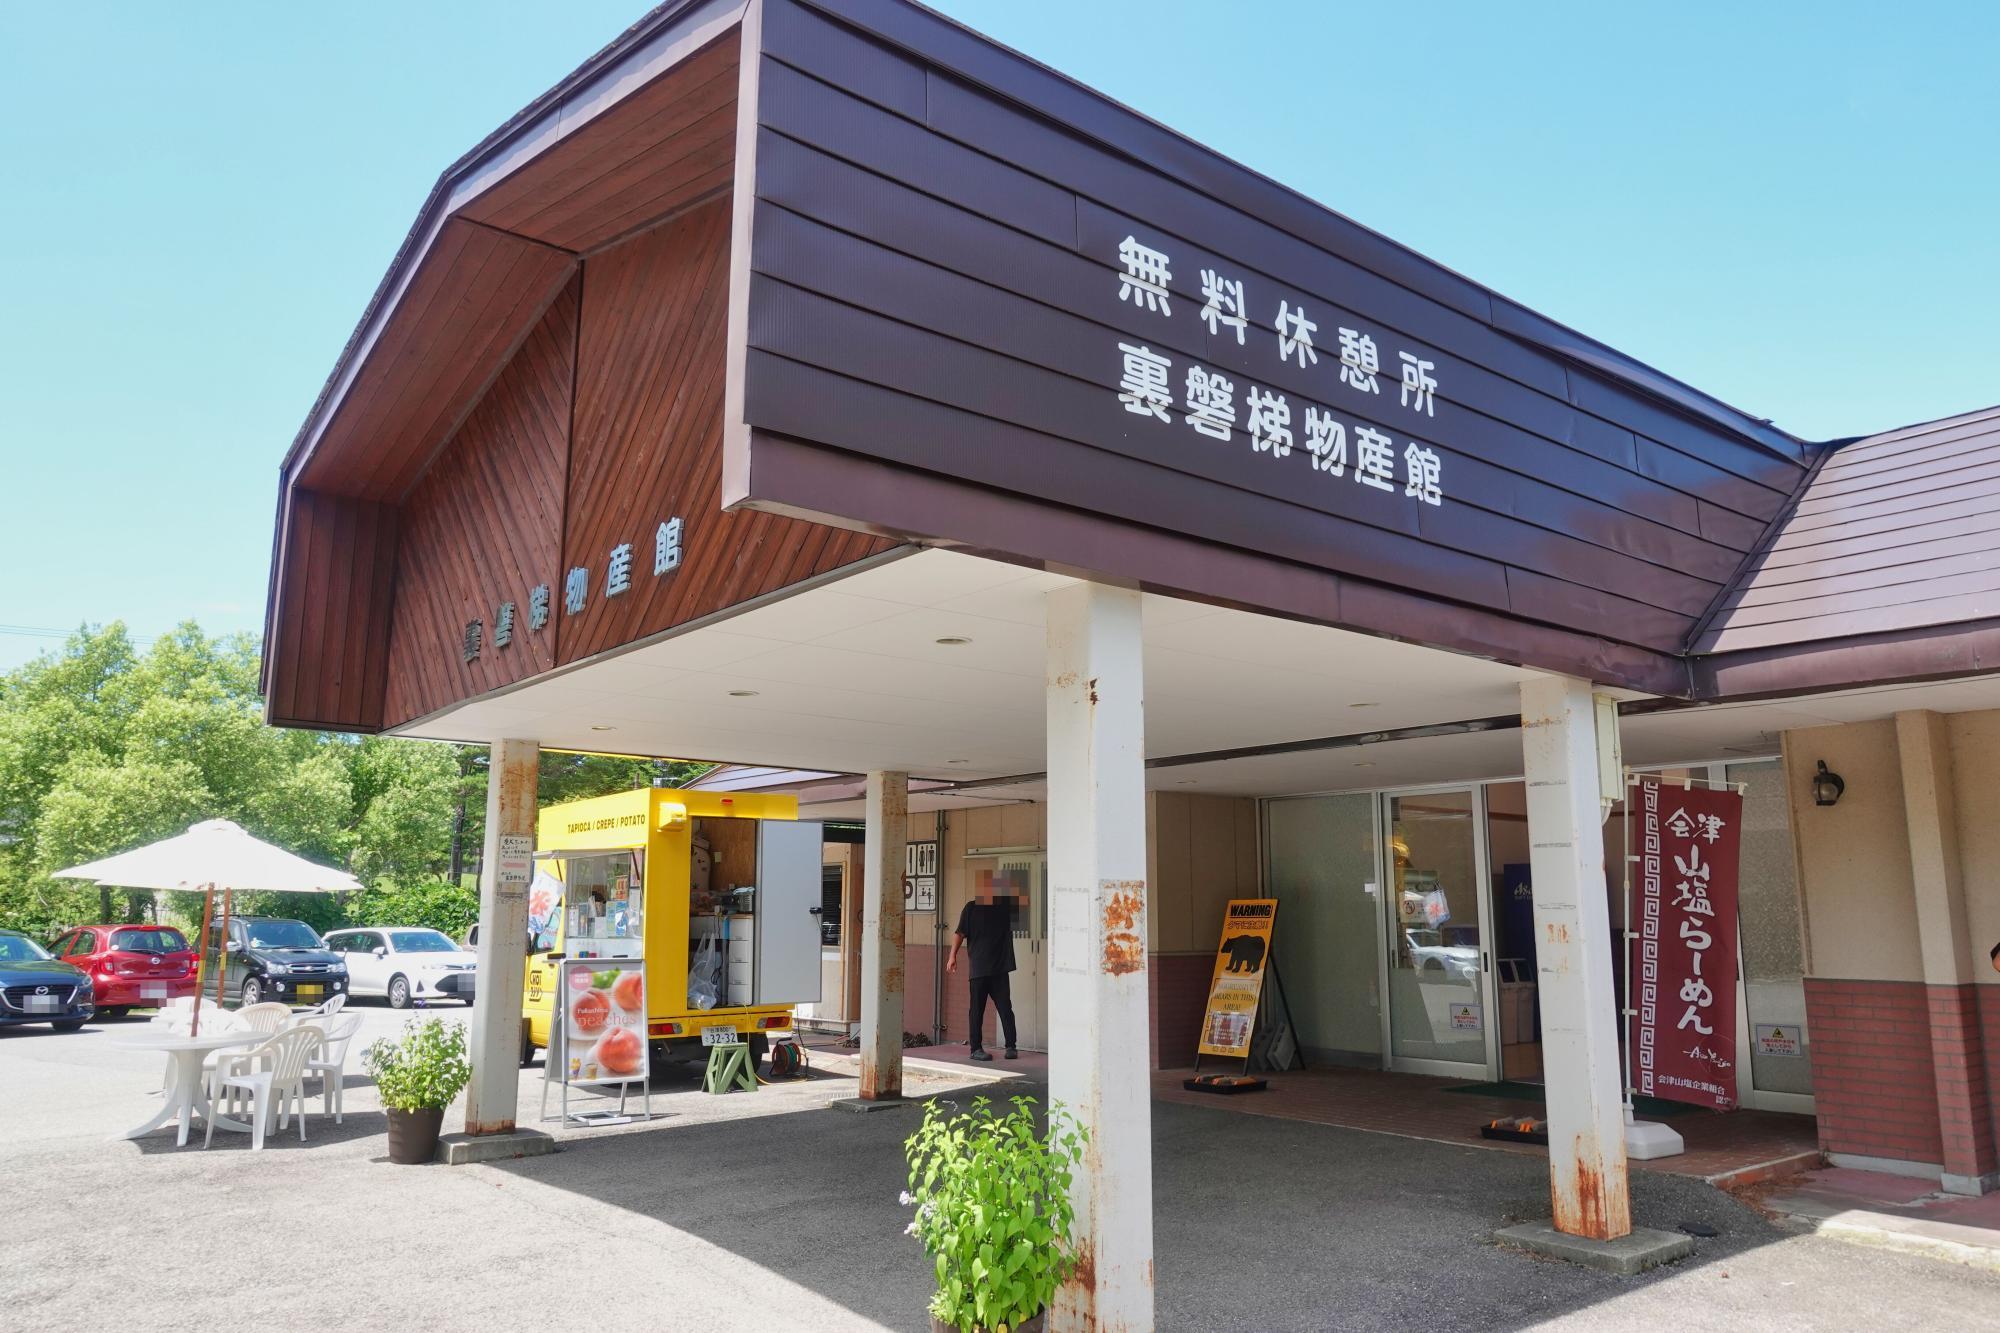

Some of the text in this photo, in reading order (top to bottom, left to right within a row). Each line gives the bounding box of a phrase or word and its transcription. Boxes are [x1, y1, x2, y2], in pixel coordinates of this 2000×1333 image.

[1118, 235, 1438, 418] 無料休憩所
[1118, 342, 1443, 507] 裏磐梯物産館
[567, 821, 591, 834] TAPIOCA
[596, 818, 615, 831] CREPE
[620, 813, 646, 828] POTATO
[1664, 806, 1726, 844] 会津
[1230, 903, 1272, 917] WARNING
[1671, 844, 1716, 1035] 山塩らーめん
[710, 1032, 736, 1044] 32-32
[1658, 1074, 1725, 1096] 会津山塩企業組合
